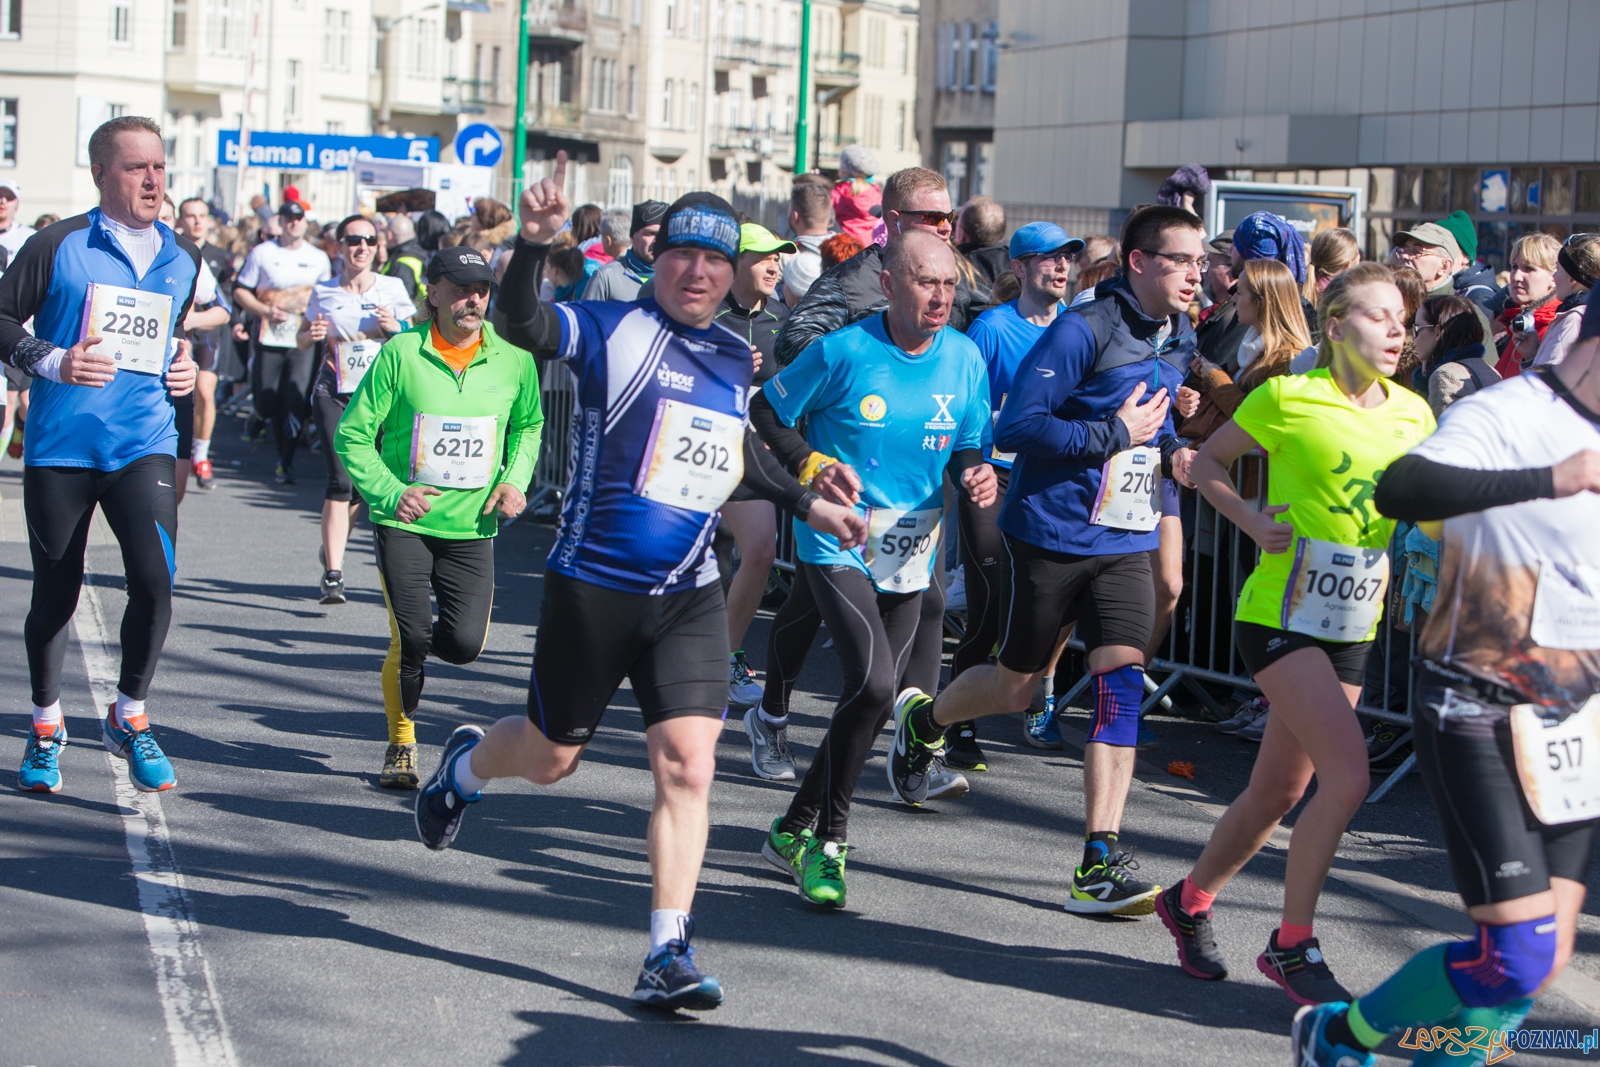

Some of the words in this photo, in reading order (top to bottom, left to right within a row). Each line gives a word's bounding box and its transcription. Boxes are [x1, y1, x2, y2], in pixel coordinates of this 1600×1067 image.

[407, 140, 430, 162] 5
[102, 311, 159, 340] 2288
[121, 338, 141, 347] Daniel
[930, 394, 956, 422] X
[432, 438, 484, 458] 6212
[582, 410, 599, 493] EXTREME
[673, 436, 729, 473] 2612
[687, 469, 713, 480] Norbert
[880, 533, 931, 558] 5950
[1306, 569, 1383, 602] 10067
[1324, 601, 1358, 613] Agnieszka
[1547, 737, 1583, 771] 517
